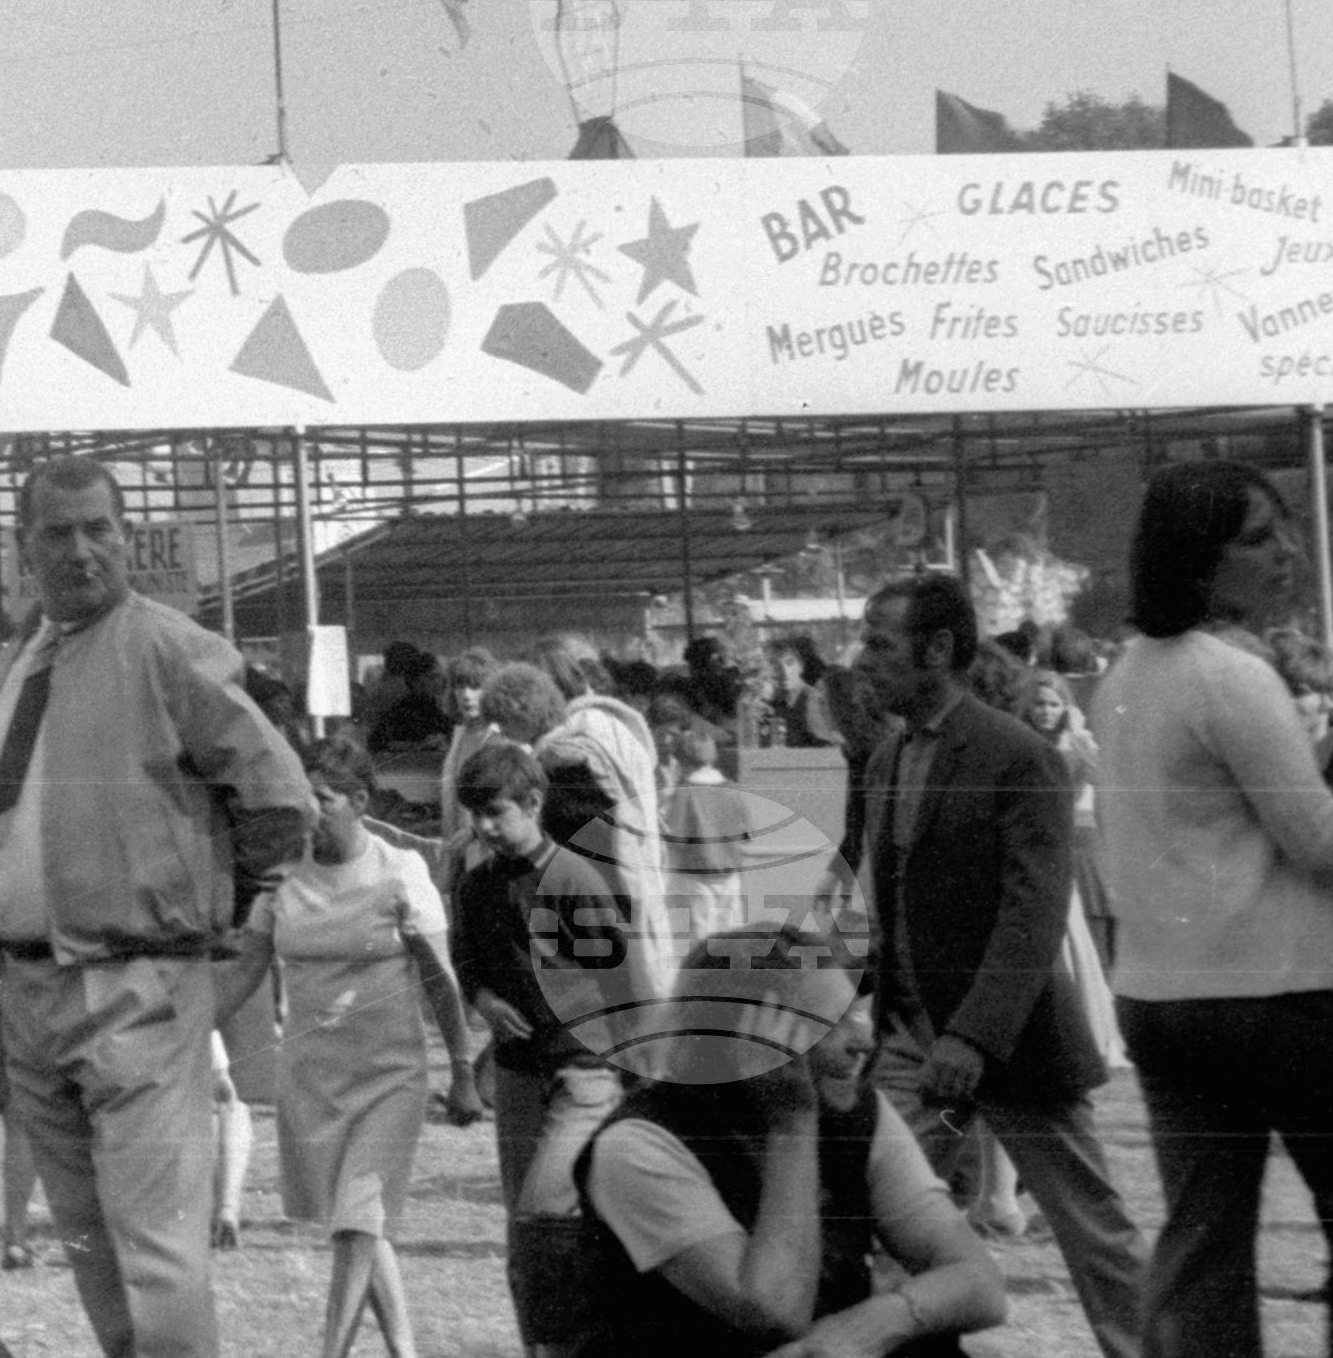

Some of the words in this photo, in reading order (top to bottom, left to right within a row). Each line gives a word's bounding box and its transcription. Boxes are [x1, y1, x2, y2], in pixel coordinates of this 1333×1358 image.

[957, 179, 1121, 217] GLACES
[760, 184, 867, 265] BAR
[818, 251, 1000, 287] Brochettes
[1032, 226, 1210, 292] Sandwiches
[929, 300, 1019, 340] Frites
[1056, 305, 1204, 339] Saucisses
[894, 358, 1020, 396] Moules
[1259, 351, 1333, 385] spéc
